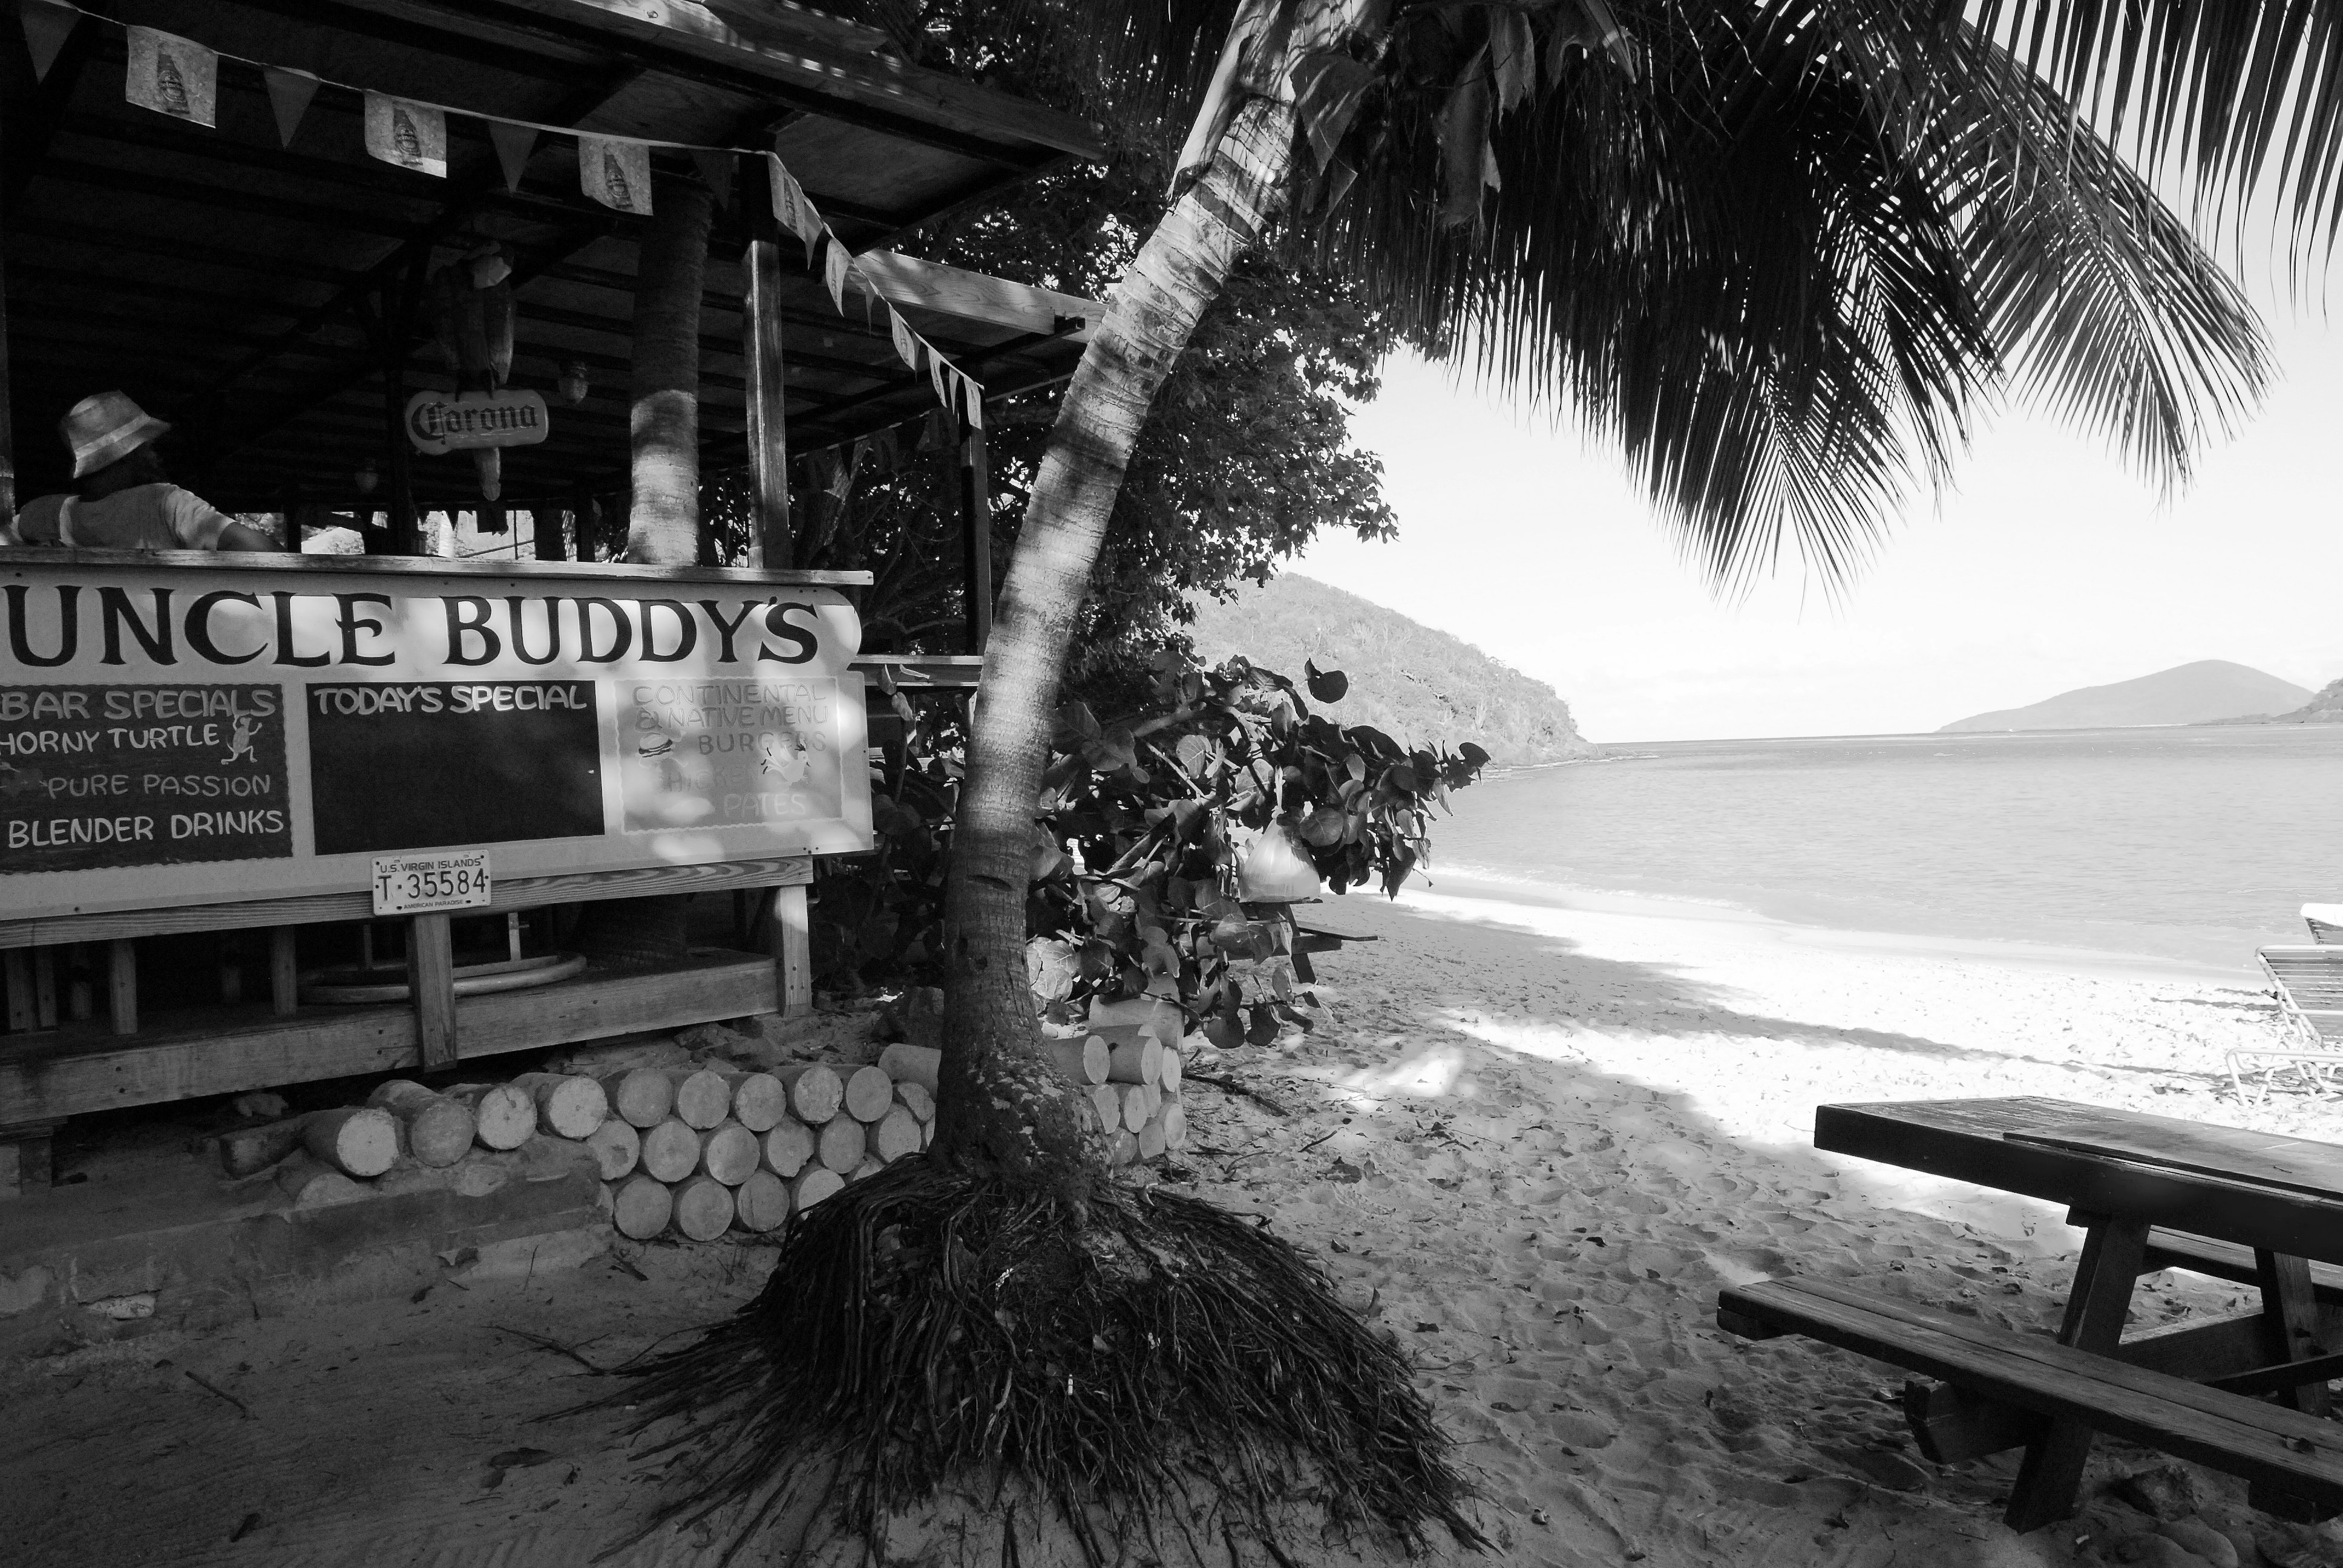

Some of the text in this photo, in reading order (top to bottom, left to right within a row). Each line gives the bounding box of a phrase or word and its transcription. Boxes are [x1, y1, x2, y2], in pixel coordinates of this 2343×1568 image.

[411, 402, 539, 445] Corona
[1, 584, 819, 667] UNCLE BUDDY'S
[0, 689, 276, 721] BAR SPECIALS
[313, 685, 587, 715] TODAY'S SPECIAL
[632, 683, 827, 707] CONTINENTAL
[667, 705, 756, 728] NATIVE
[759, 705, 828, 727] MENU
[0, 724, 220, 755] HORNY TURTLE
[48, 774, 270, 800] PURE PASSION
[724, 791, 807, 817] PATES
[8, 809, 284, 848] BLENDER DRINKS
[380, 858, 482, 874] U.S. VIRGIN ISLANDS
